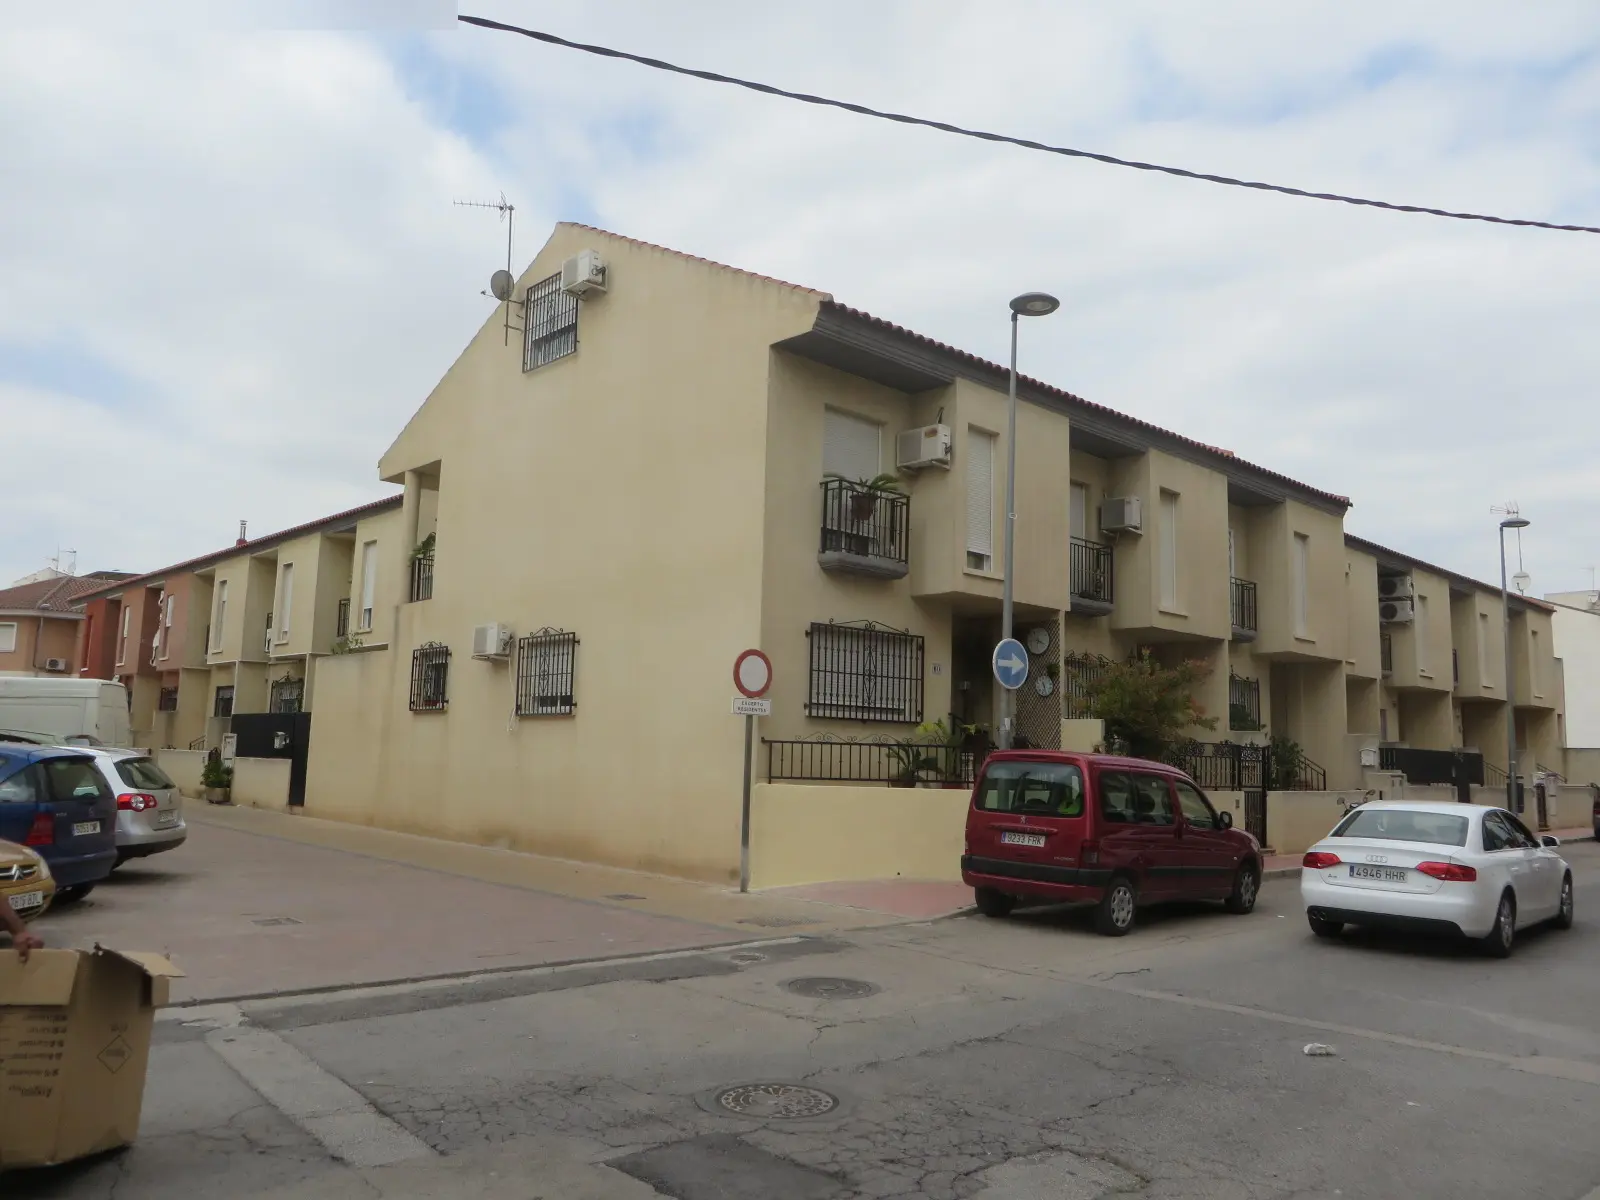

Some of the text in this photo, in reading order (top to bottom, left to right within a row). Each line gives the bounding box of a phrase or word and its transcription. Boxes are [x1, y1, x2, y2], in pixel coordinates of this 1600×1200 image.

[1007, 833, 1043, 846] 9233 FRK
[1356, 867, 1406, 881] 4946 HHR
